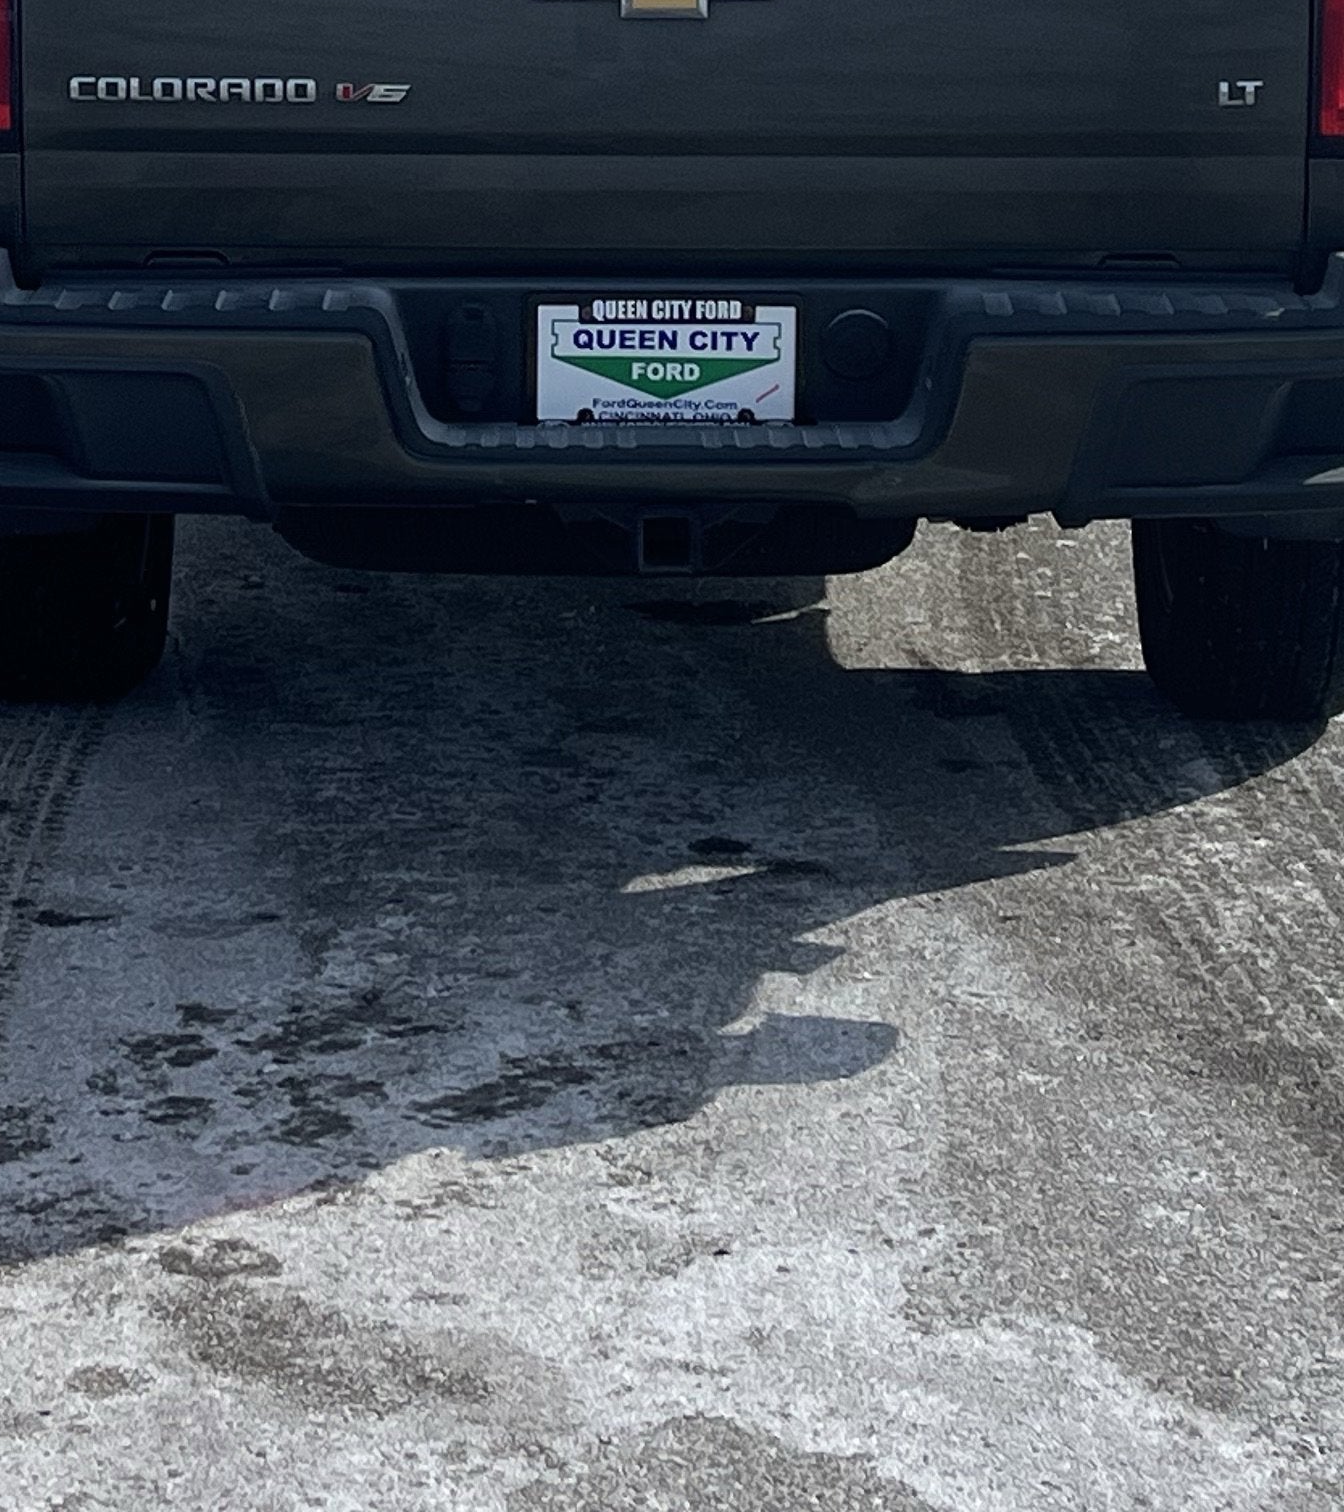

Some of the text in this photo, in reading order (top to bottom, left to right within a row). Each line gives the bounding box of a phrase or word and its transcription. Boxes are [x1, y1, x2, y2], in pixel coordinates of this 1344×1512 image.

[69, 76, 316, 103] COLORADO
[1218, 80, 1264, 106] LT
[592, 300, 742, 321] QUEEN CITY FORD
[573, 329, 760, 351] QUEEN CITY
[631, 362, 700, 381] FORD
